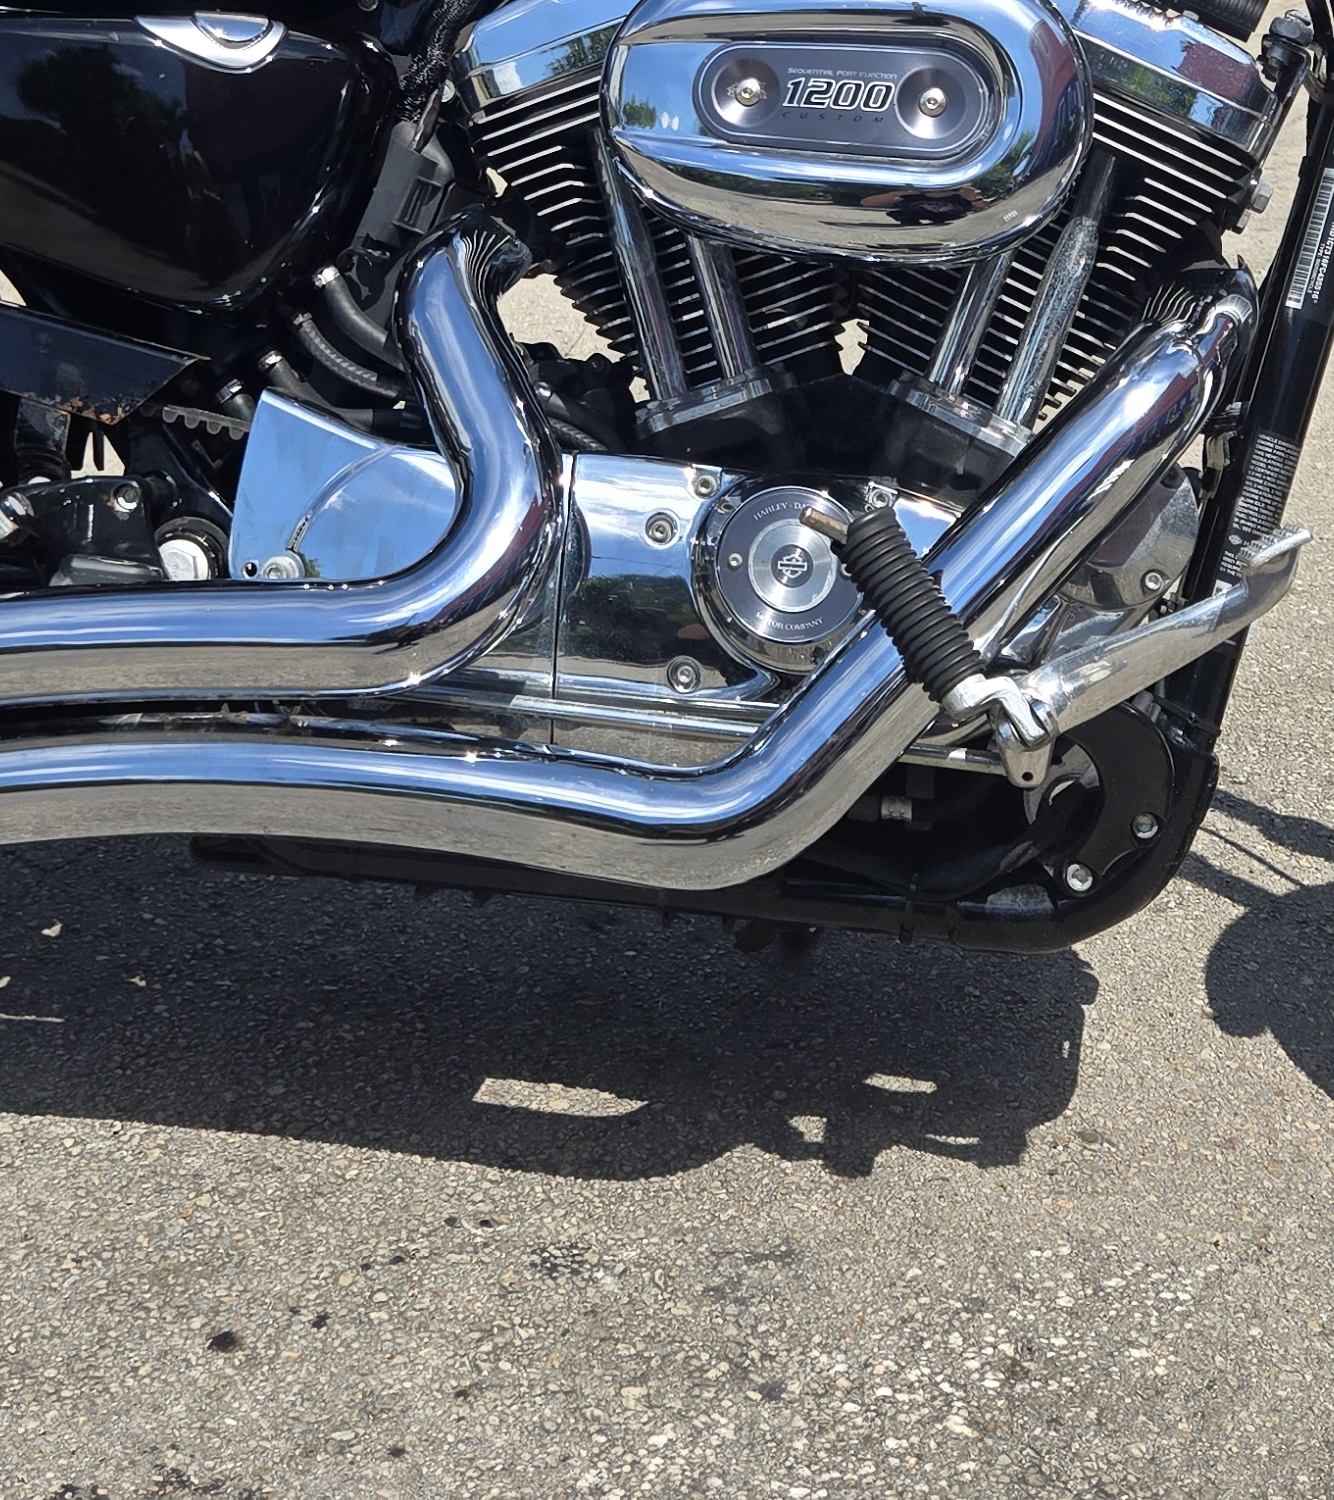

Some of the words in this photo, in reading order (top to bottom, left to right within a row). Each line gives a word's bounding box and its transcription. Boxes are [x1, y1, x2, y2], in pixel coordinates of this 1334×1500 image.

[782, 77, 896, 112] 1200
[782, 111, 885, 124] CUSTOM
[753, 501, 788, 521] HARLEY
[784, 616, 824, 631] COMPANY
